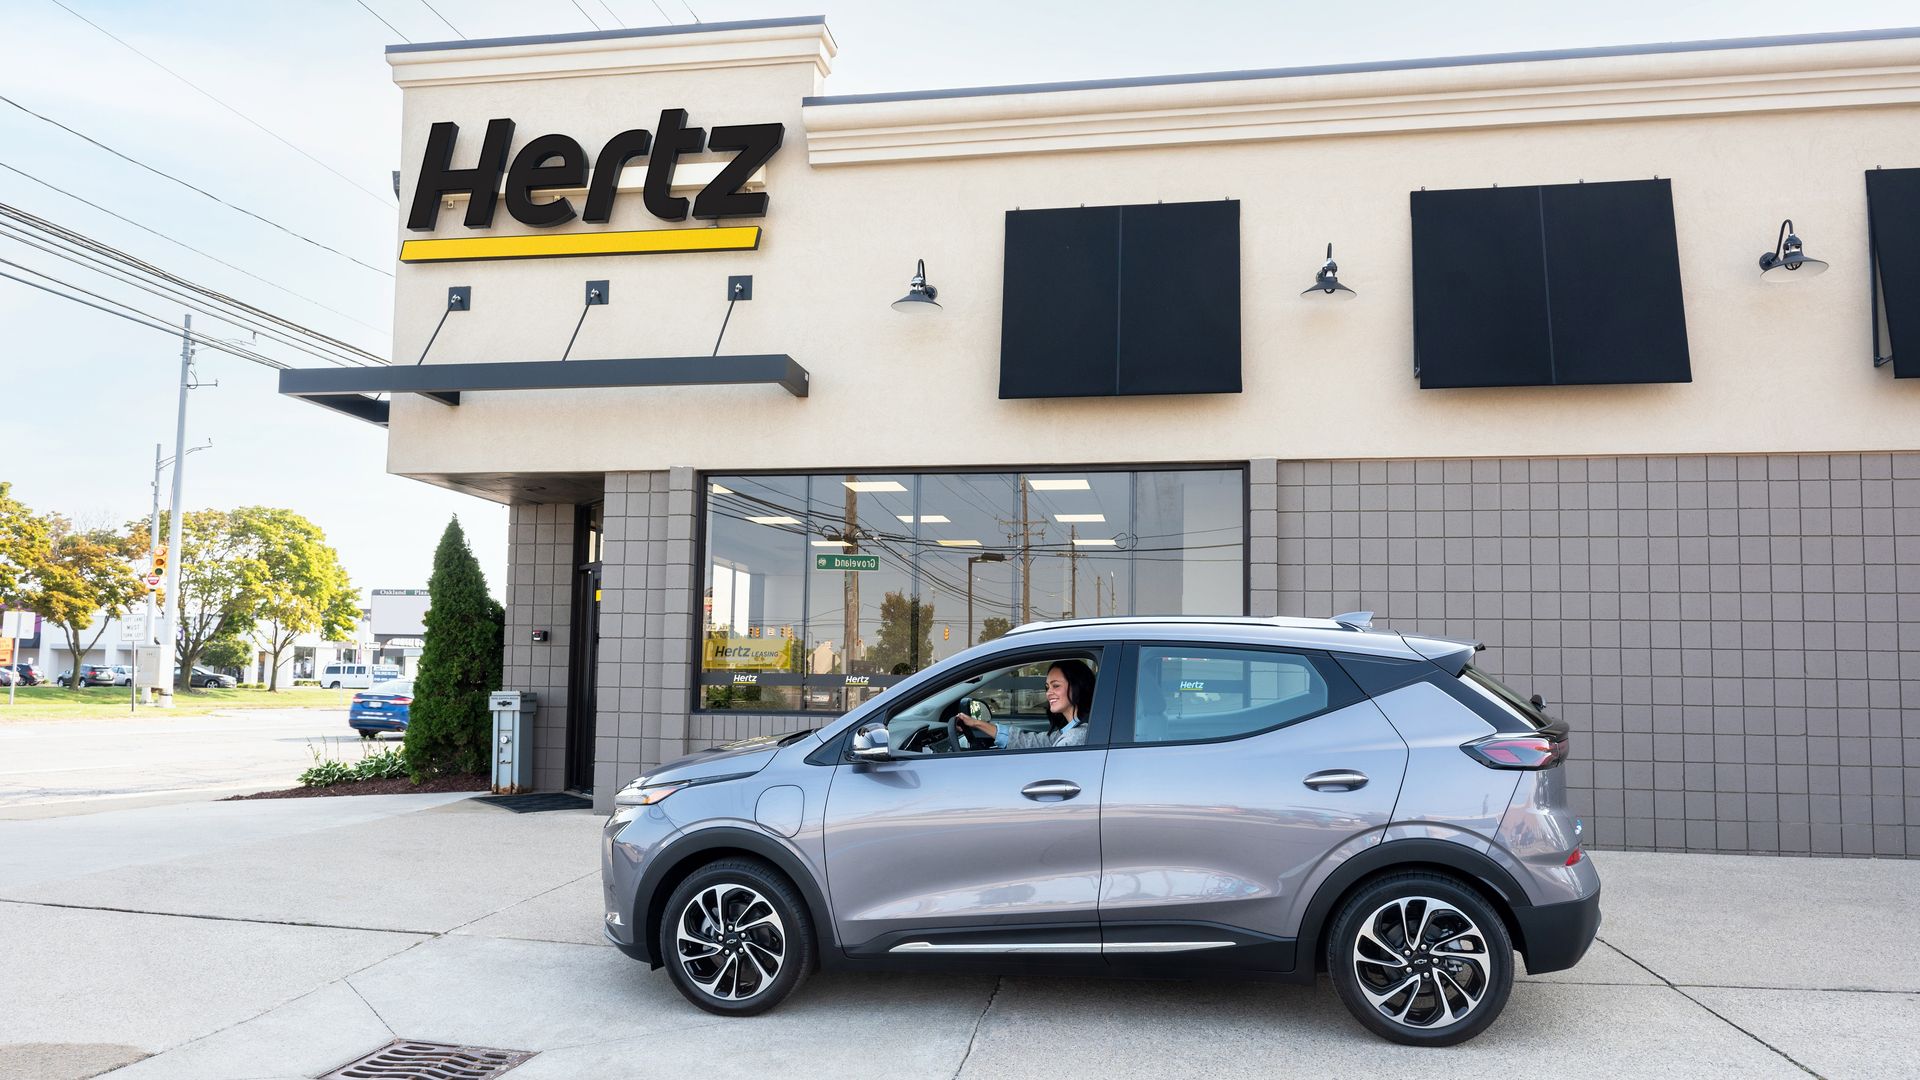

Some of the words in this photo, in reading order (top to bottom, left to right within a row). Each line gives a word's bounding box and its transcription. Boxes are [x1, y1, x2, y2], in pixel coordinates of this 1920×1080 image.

[407, 108, 785, 231] Hertz
[715, 646, 751, 657] Hertz
[733, 674, 758, 682] Hertz
[845, 675, 870, 683] Hertz
